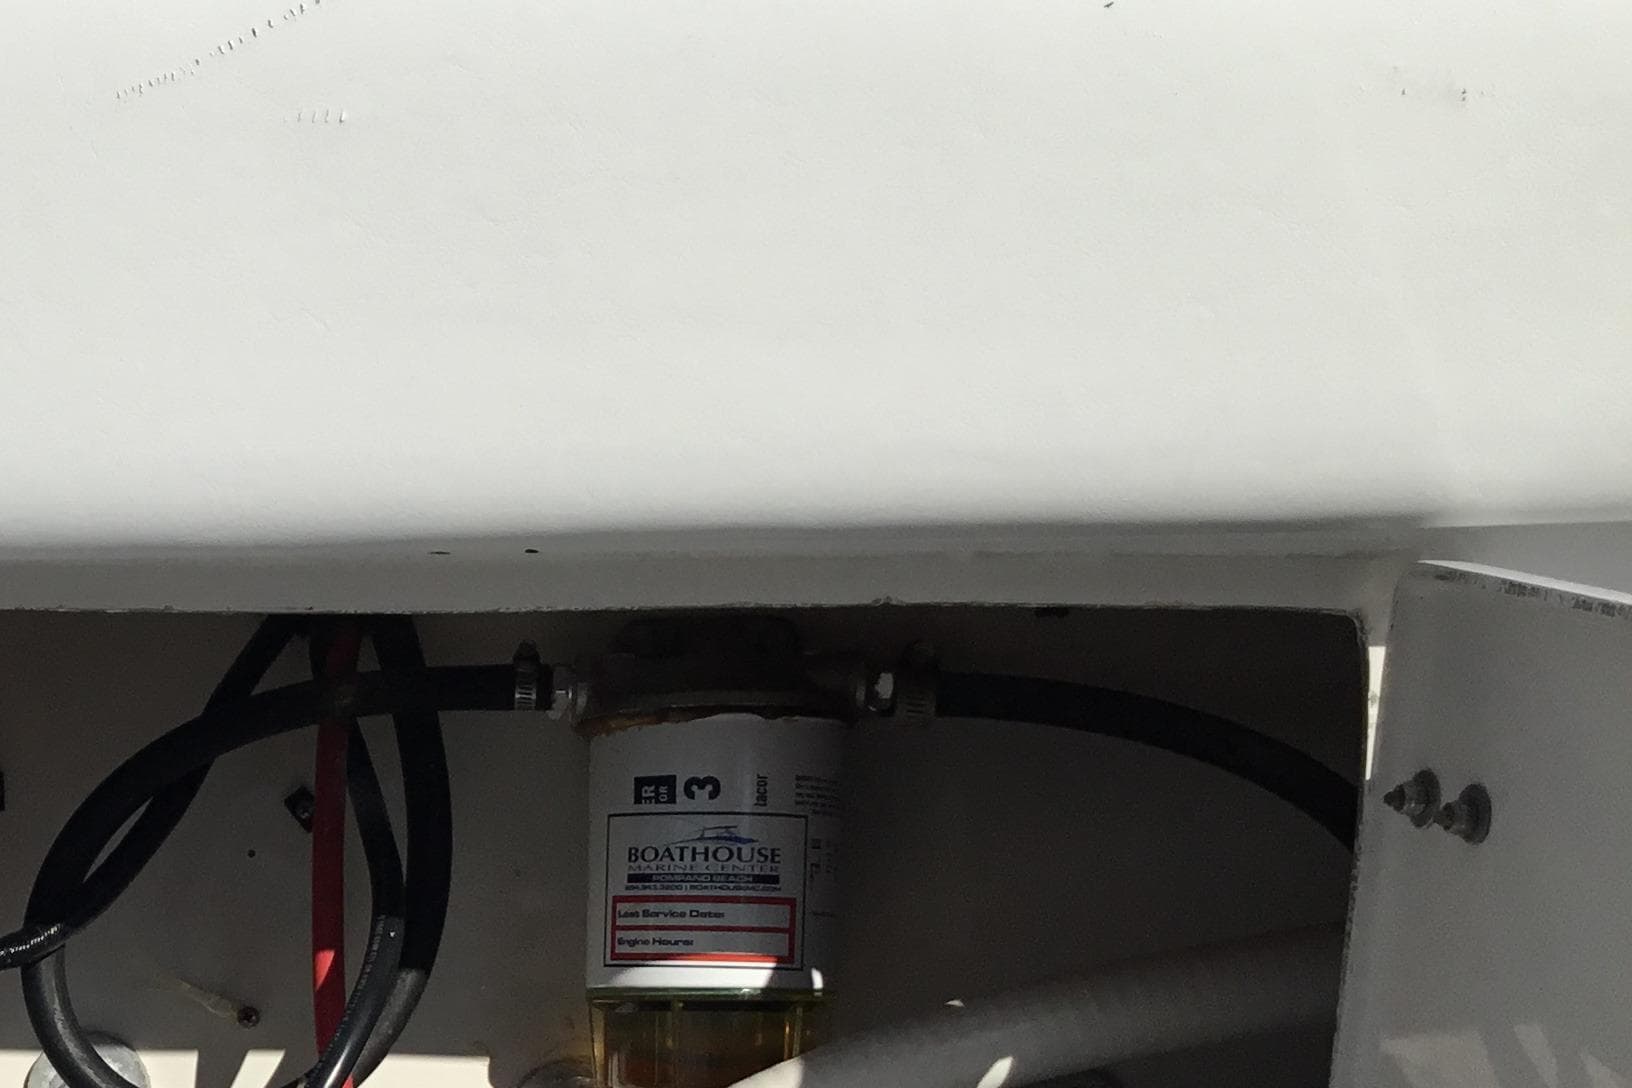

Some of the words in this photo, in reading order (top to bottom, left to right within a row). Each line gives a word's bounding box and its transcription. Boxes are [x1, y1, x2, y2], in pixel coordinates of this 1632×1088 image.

[627, 846, 781, 864] BOATHOUSE
[627, 863, 698, 872] MARINE
[703, 864, 780, 873] CENTER
[712, 874, 753, 882] BEACH
[618, 910, 640, 918] Last
[642, 909, 686, 918] Service
[617, 937, 650, 947] Engine
